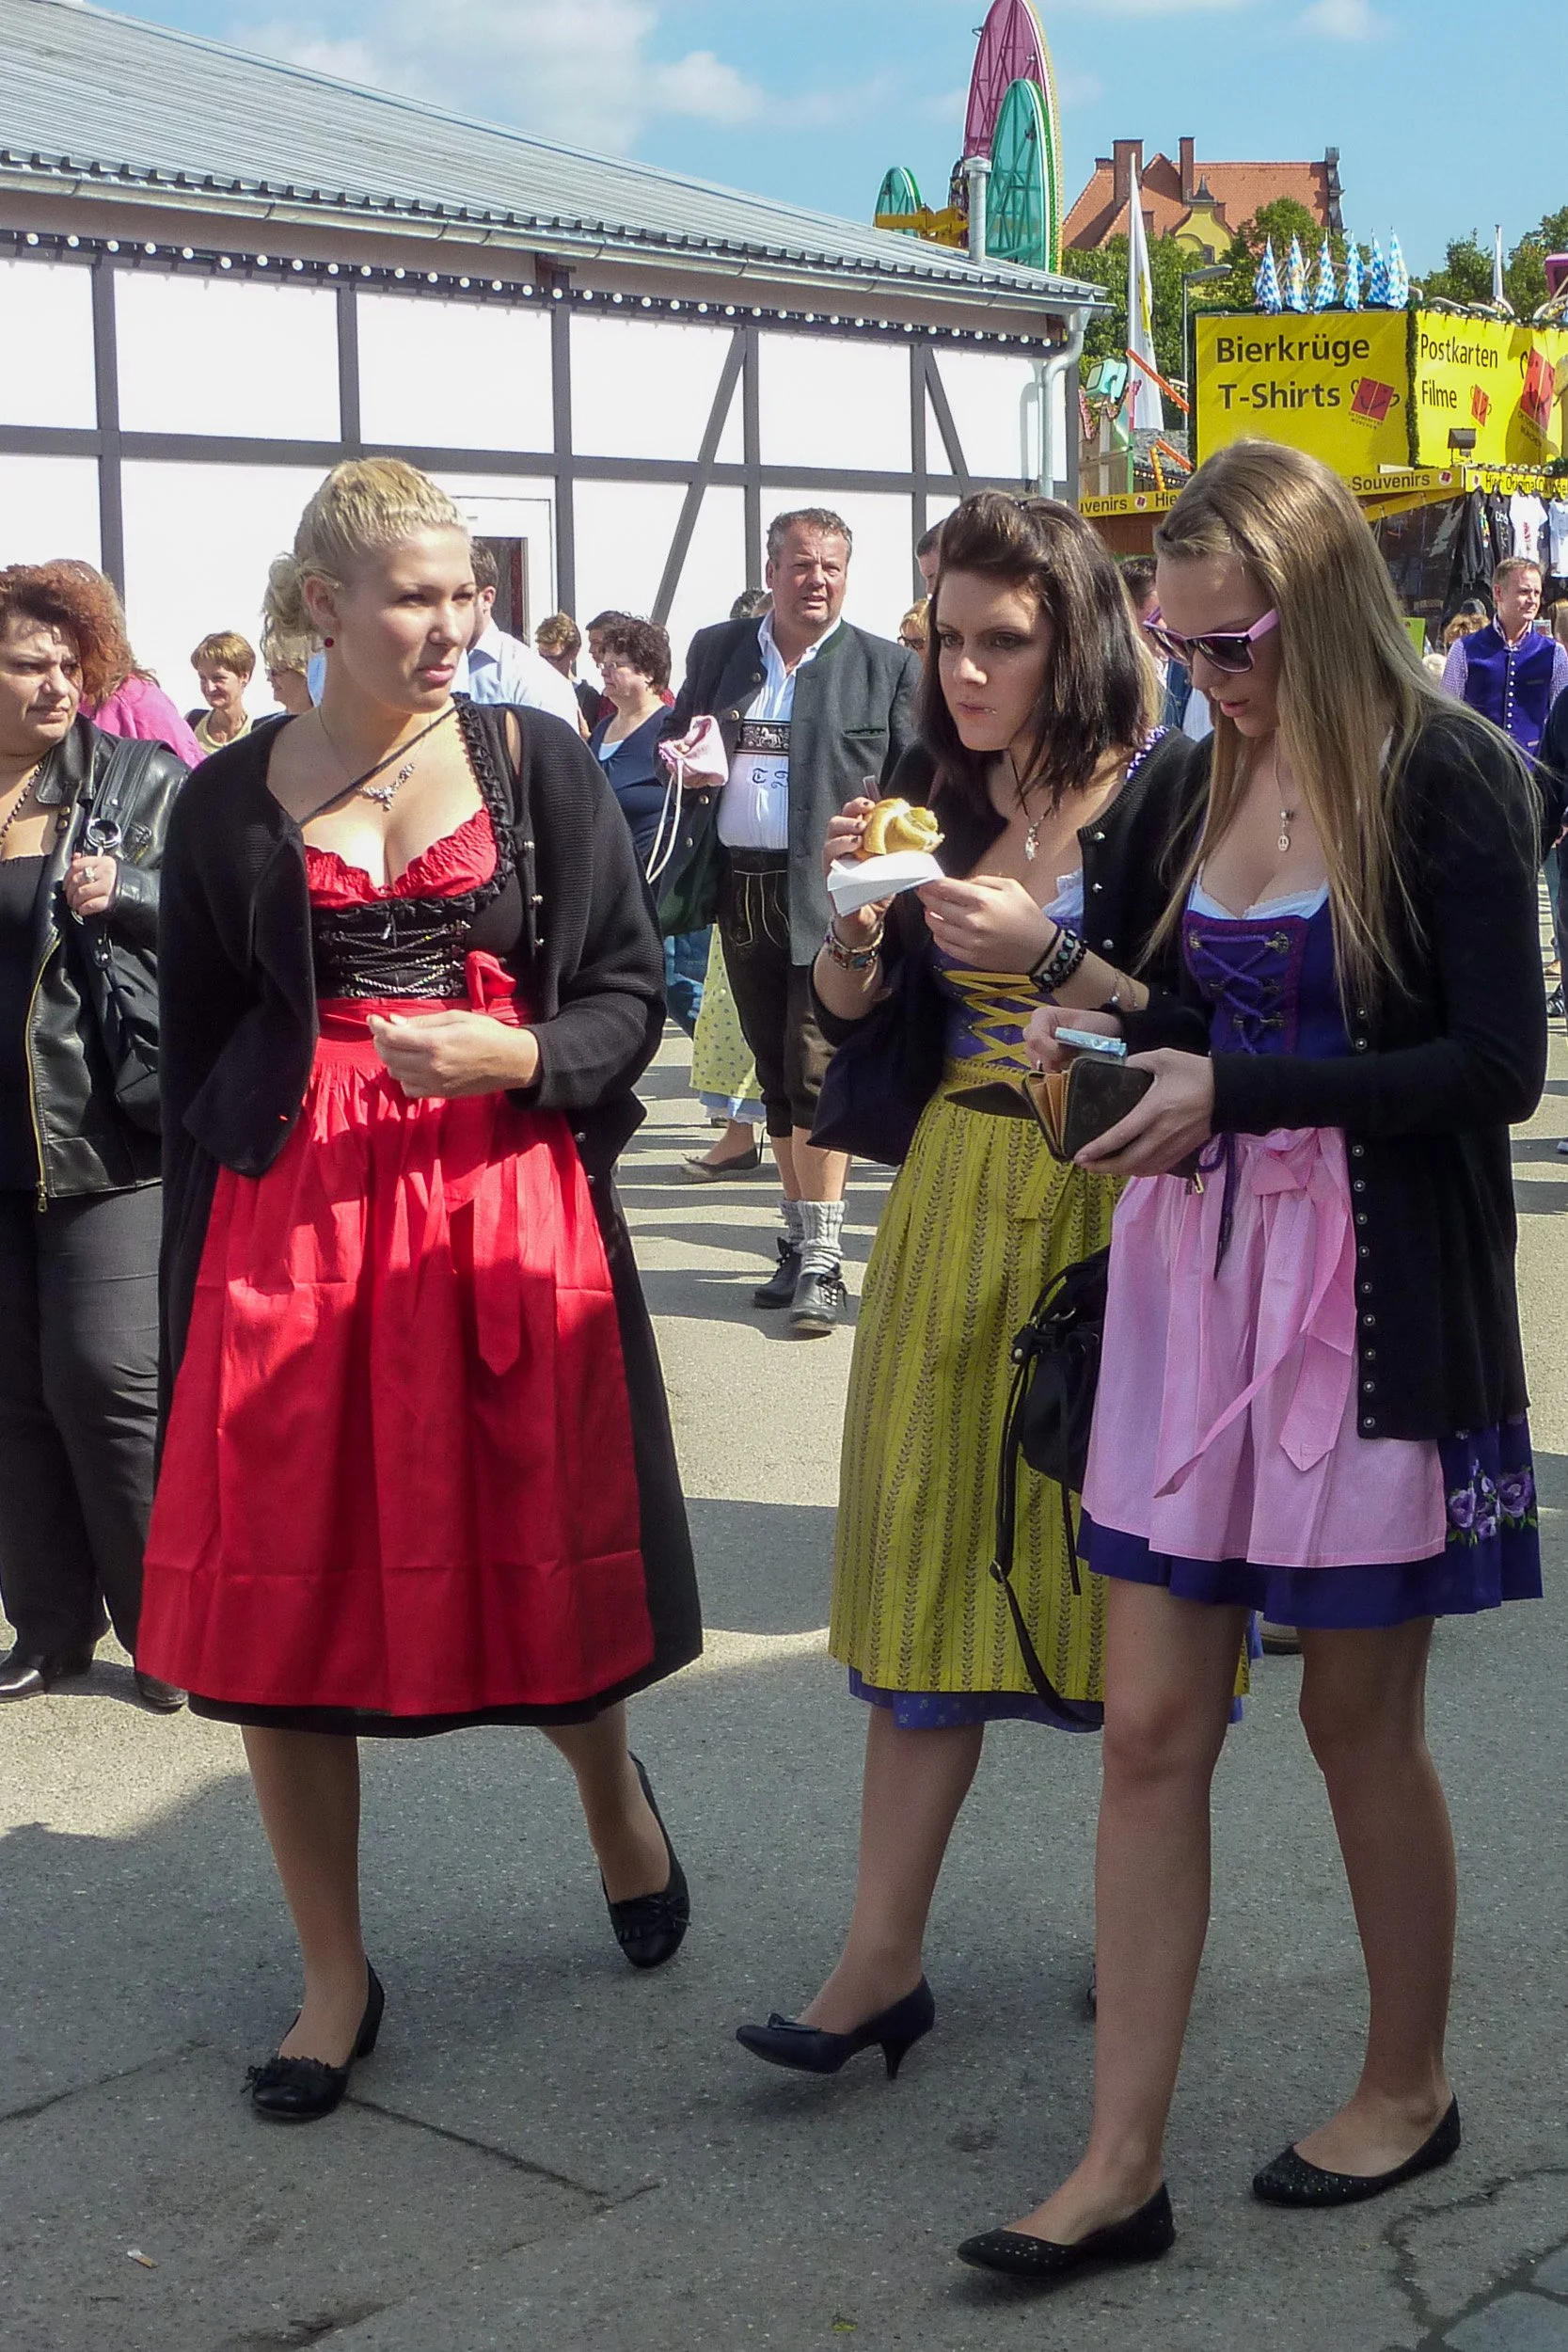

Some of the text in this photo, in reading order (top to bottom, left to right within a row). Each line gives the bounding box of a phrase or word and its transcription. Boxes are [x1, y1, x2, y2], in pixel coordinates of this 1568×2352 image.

[1216, 333, 1370, 367] Bierkrüge
[1420, 333, 1498, 369] Postkarten
[1217, 381, 1340, 409] T-Shirts
[1421, 379, 1457, 409] Filme
[1348, 471, 1430, 491] Souvenirs
